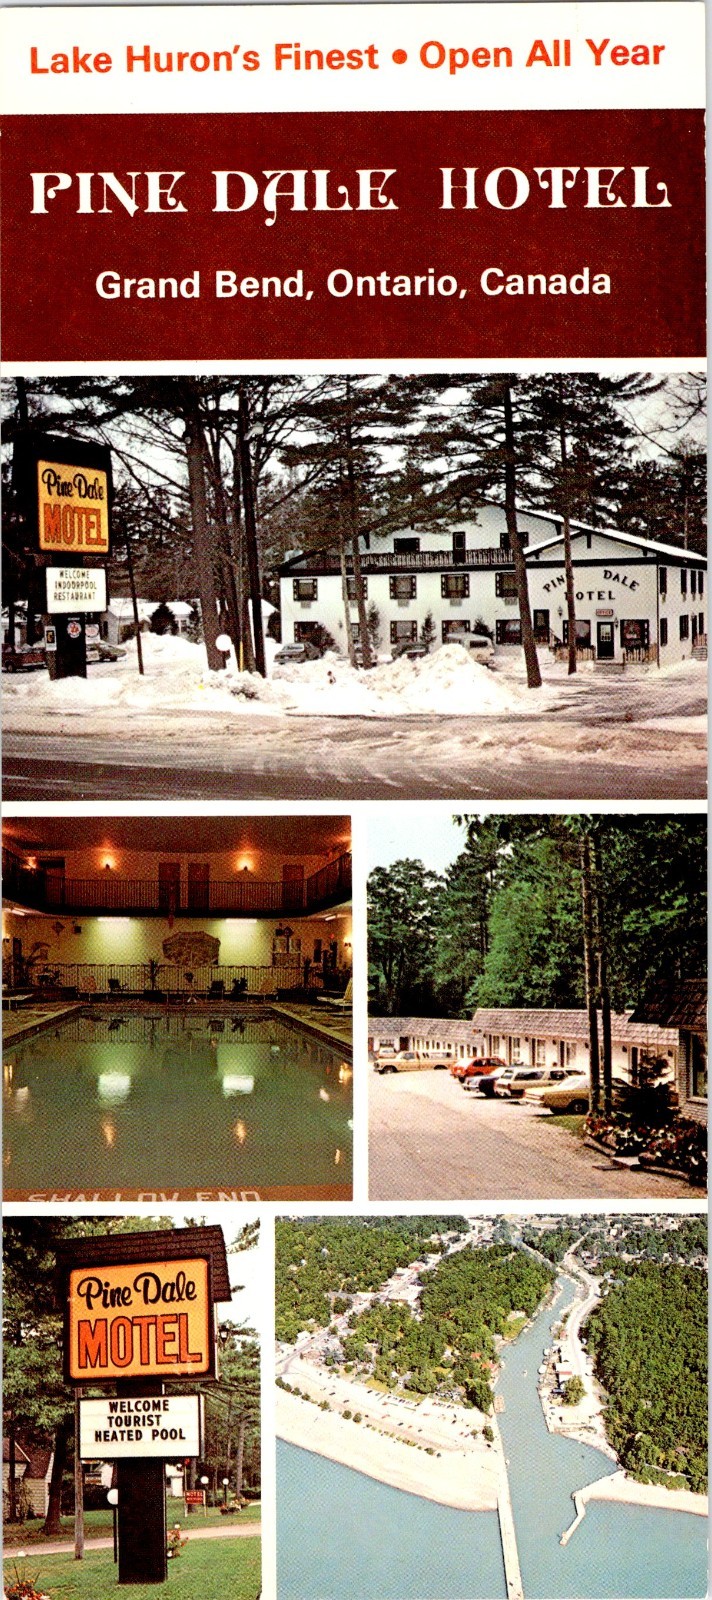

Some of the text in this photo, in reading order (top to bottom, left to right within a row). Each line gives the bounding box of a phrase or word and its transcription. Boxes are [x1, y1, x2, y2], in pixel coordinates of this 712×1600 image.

[31, 39, 665, 75] Lake Huron's Finest Open All Year
[30, 167, 672, 226] PINE DALE HOTEL
[96, 267, 610, 300] Grand Bend, Ontario, Canada
[42, 468, 104, 500] Pine Dale
[43, 503, 107, 546] MOTEL
[60, 570, 90, 579] WELCOME
[543, 569, 640, 592] PIN DALE
[54, 591, 96, 601] RESTAURANT
[77, 1271, 197, 1310] Pine Dale
[78, 1312, 202, 1369] MOTEL
[107, 1414, 162, 1428] TOURIST
[109, 1400, 169, 1413] WELCOME
[95, 1428, 186, 1442] HEATED POOL
